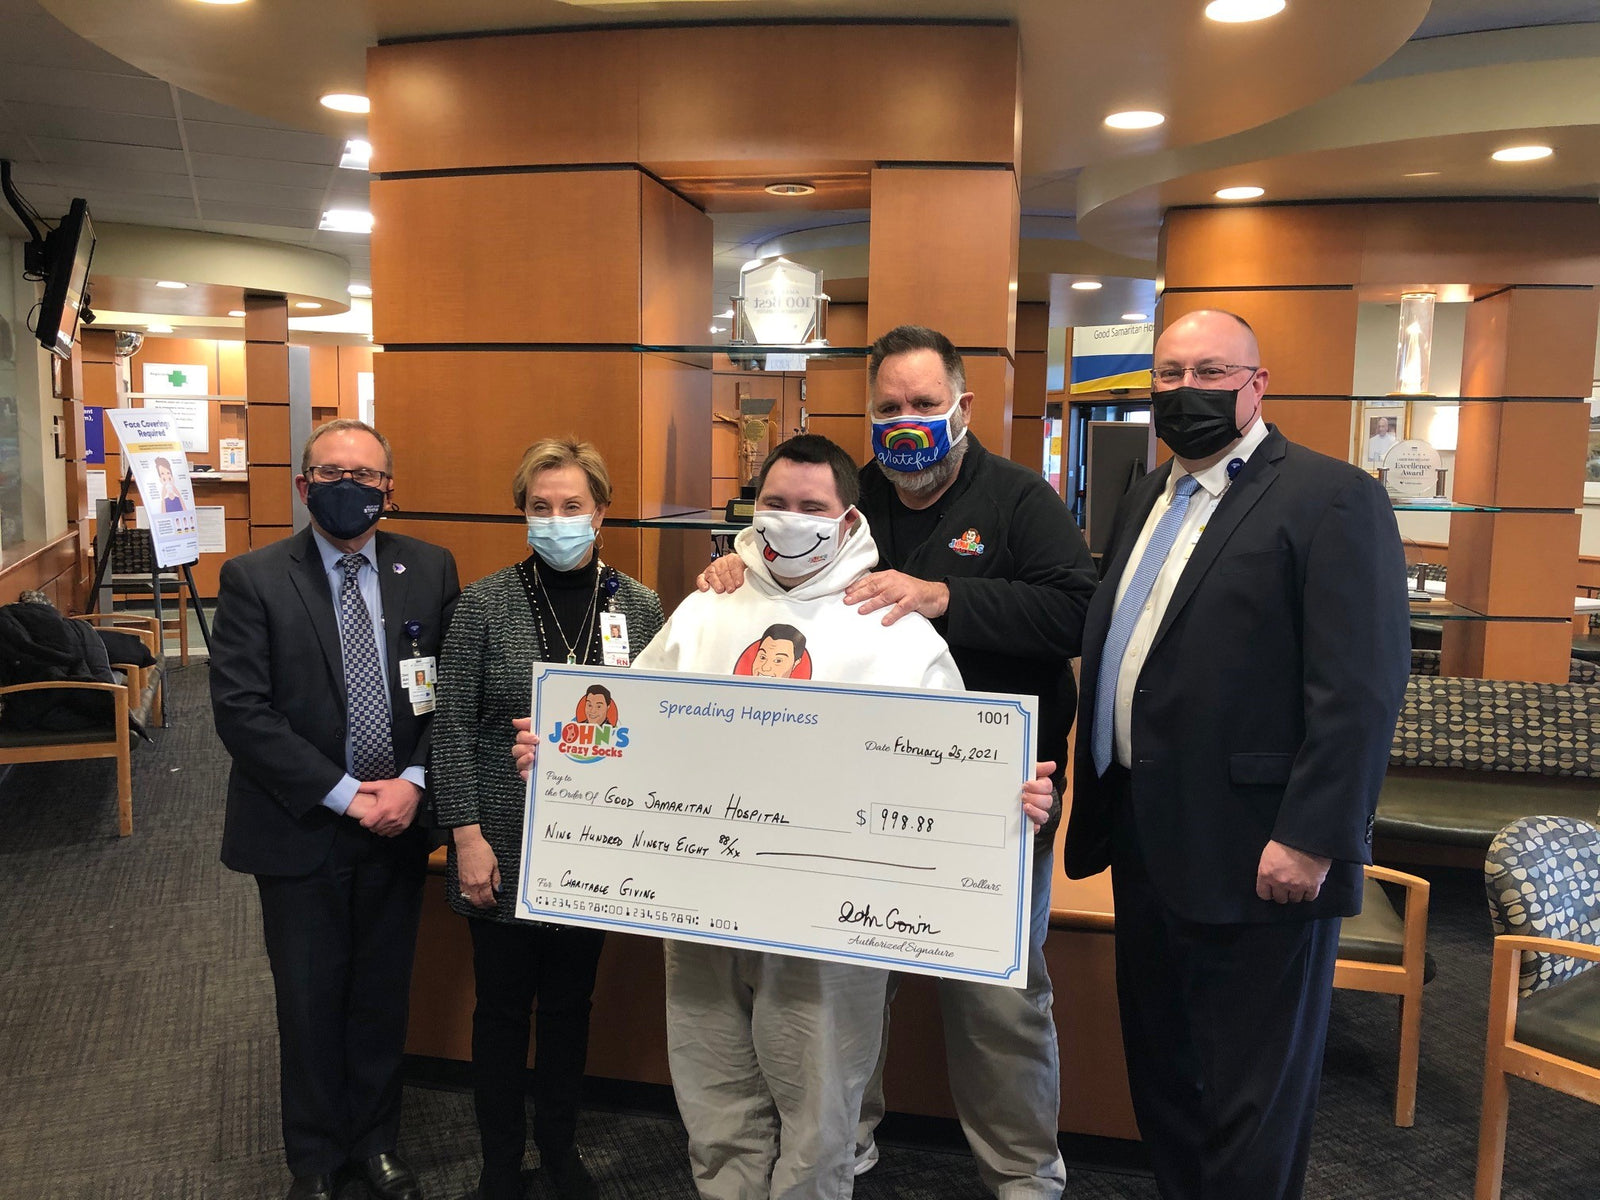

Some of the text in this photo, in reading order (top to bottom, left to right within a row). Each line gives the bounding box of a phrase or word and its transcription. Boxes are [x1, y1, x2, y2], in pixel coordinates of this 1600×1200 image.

[1094, 328, 1110, 340] Good
[1111, 324, 1142, 338] Samaritan
[123, 419, 171, 430] Face Covering
[137, 429, 166, 438] Required
[1395, 462, 1432, 470] Excellence
[659, 700, 818, 726] Spreading Happiness
[977, 711, 1010, 725] 1001
[548, 721, 630, 748] JOHN'S
[558, 742, 623, 758] Crazy Socks
[864, 740, 891, 752] Date
[893, 736, 943, 764] February
[546, 770, 572, 785] Pay to
[544, 787, 599, 805] the Order Of
[645, 791, 713, 815] SAMARITAN
[724, 793, 790, 824] HOSPITAL
[856, 809, 867, 826] $
[880, 808, 935, 833] 998.88
[961, 877, 1001, 892] Dollars
[848, 935, 955, 958] Authorized Signature
